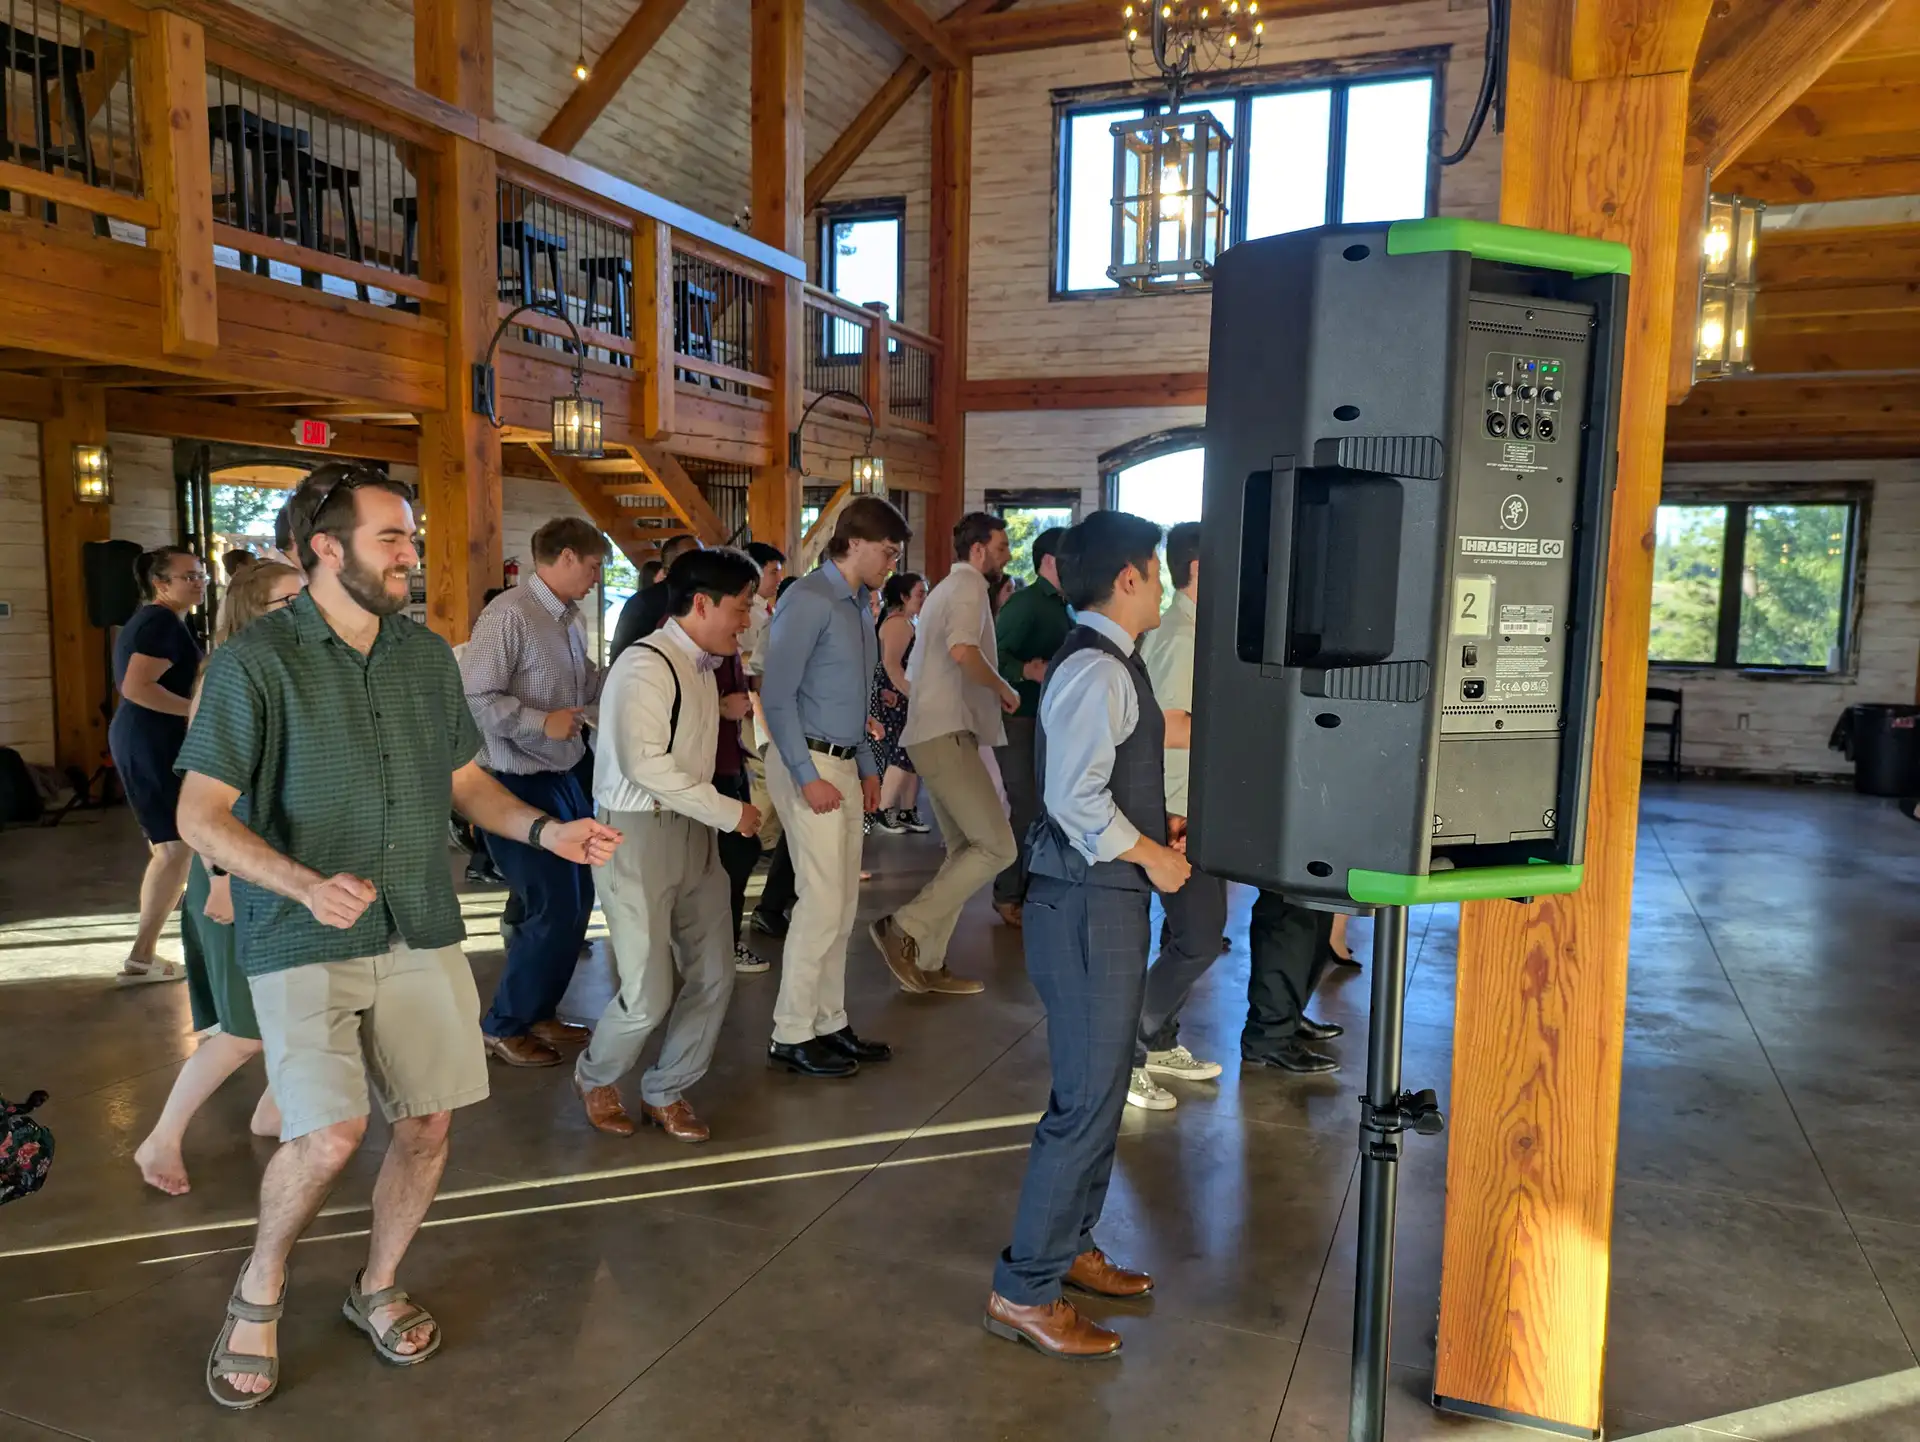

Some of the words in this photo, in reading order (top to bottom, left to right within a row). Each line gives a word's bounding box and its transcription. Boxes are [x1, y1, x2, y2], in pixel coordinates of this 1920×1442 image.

[303, 421, 327, 446] EXIT
[1542, 542, 1561, 555] GO
[1461, 593, 1477, 619] 2
